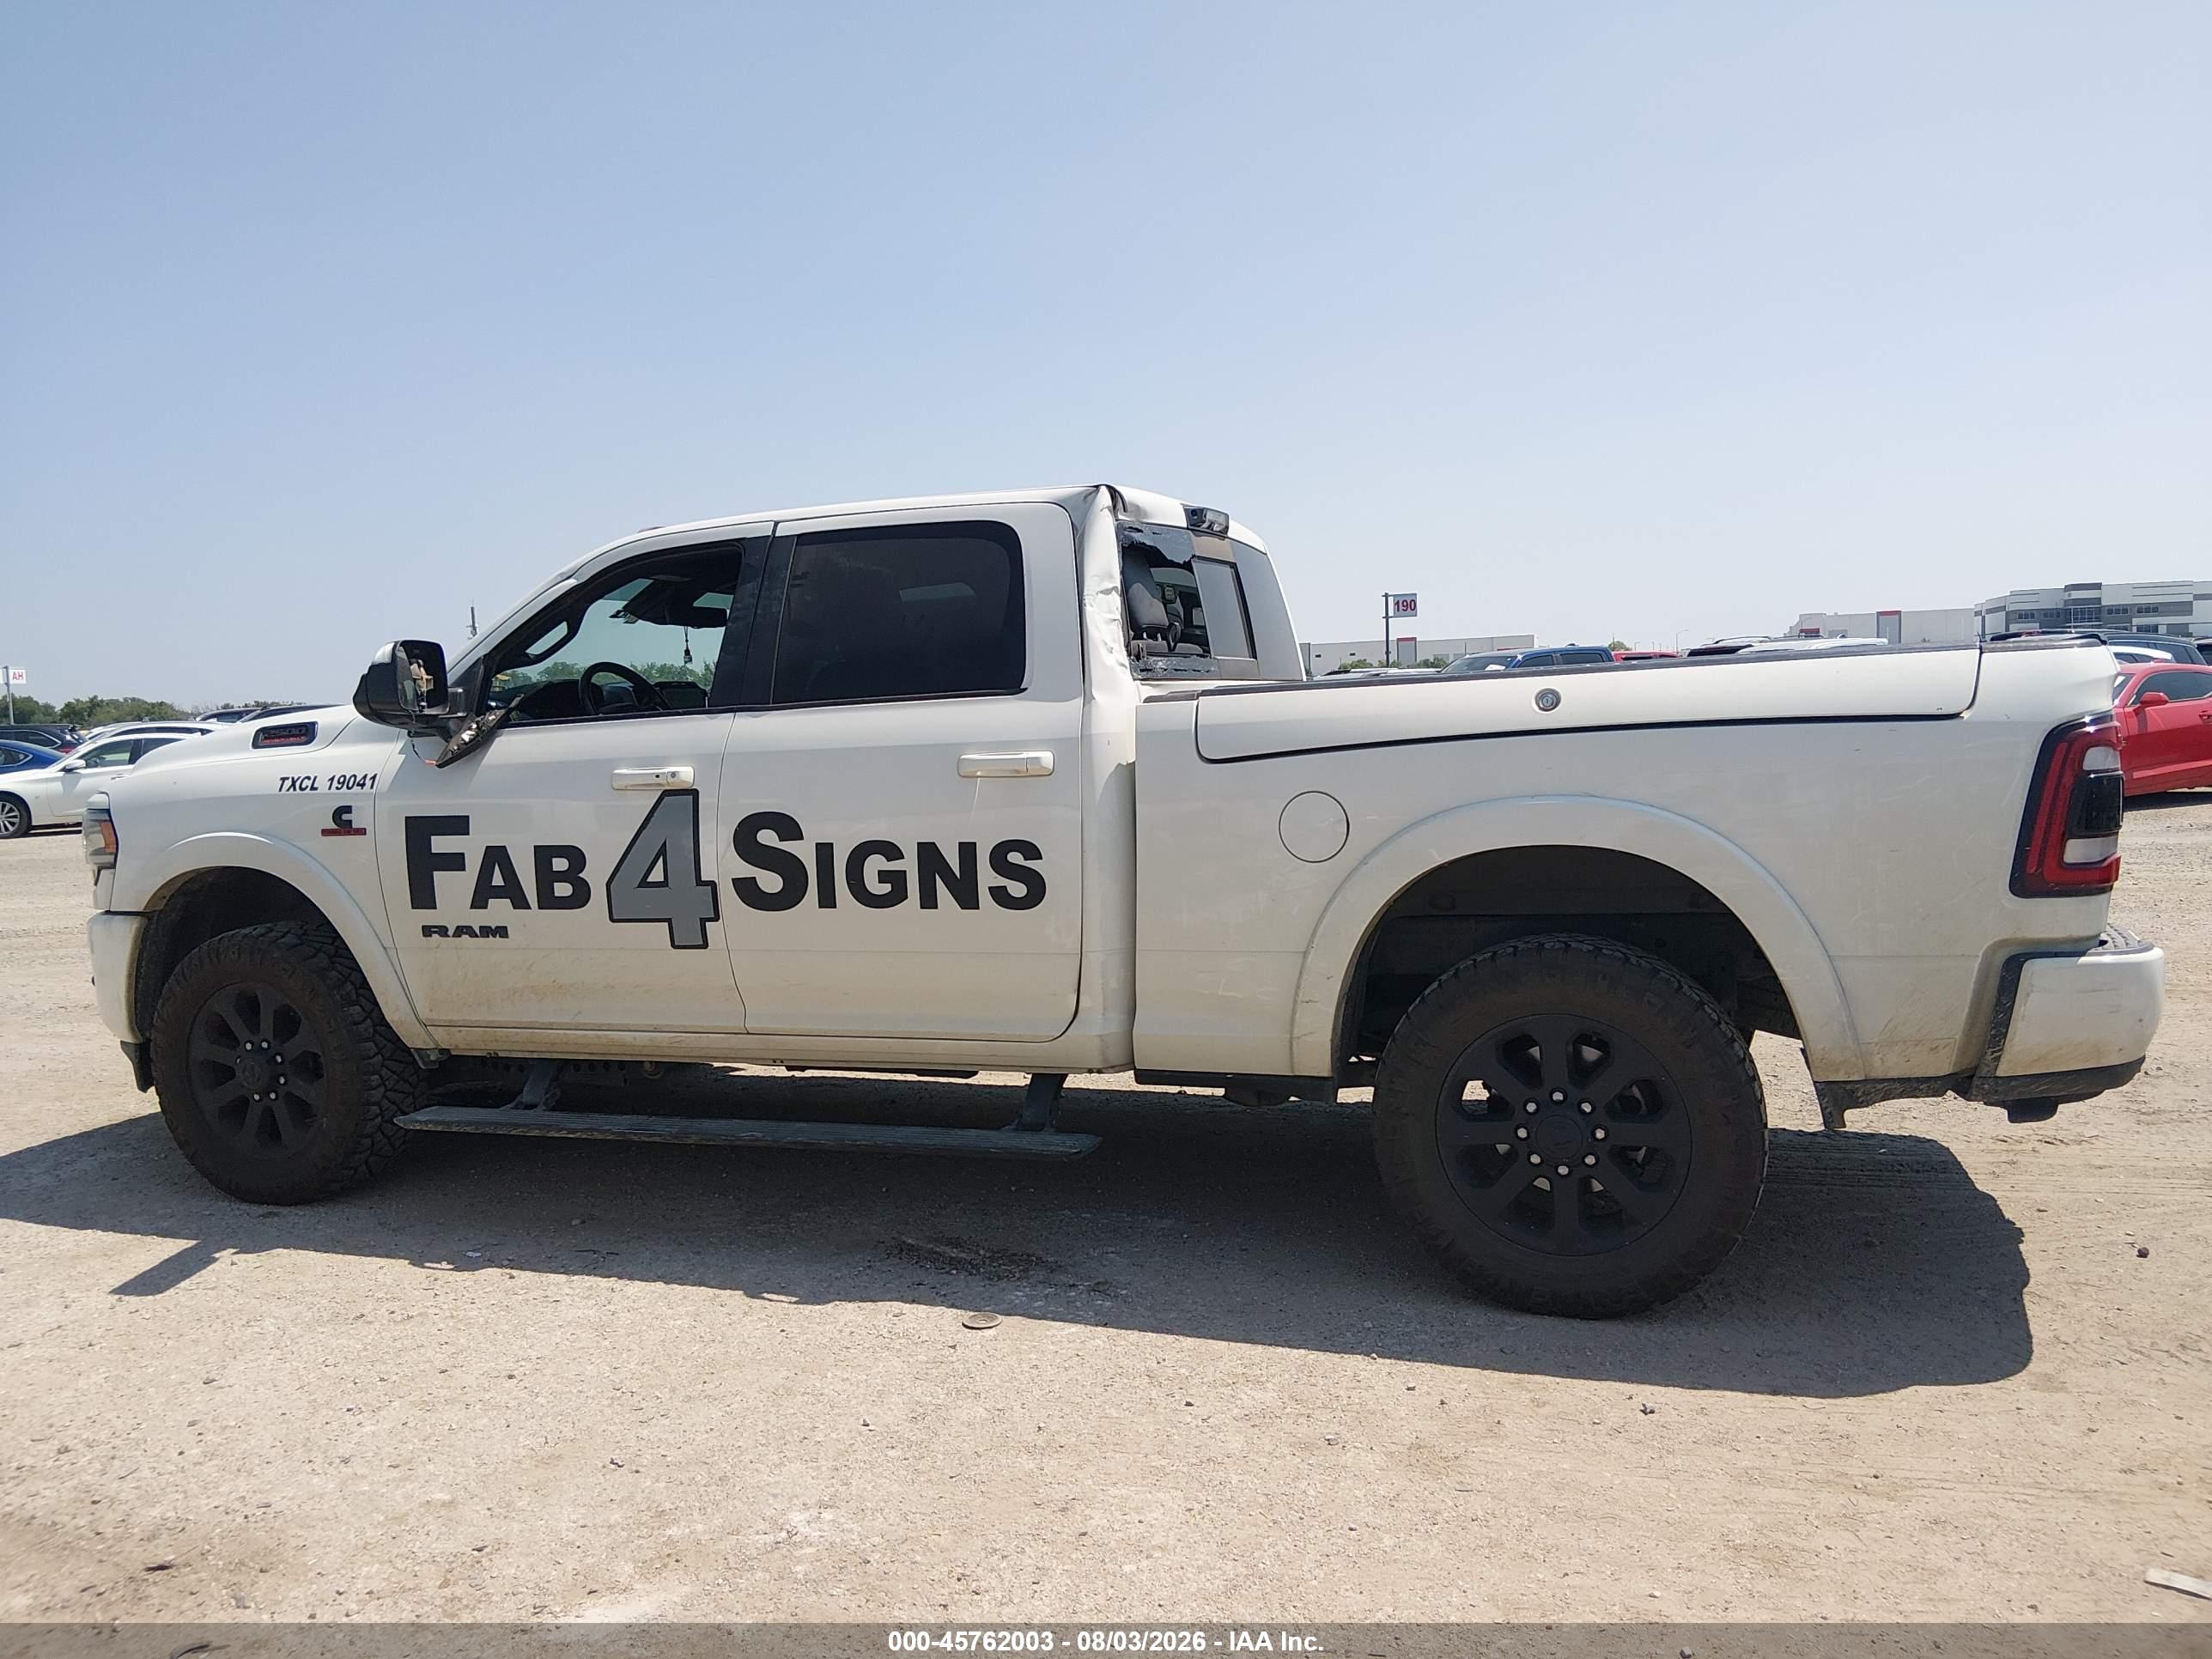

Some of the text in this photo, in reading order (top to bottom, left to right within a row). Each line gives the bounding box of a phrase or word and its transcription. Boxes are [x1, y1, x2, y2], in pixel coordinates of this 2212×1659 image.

[1394, 599, 1417, 612] 190
[12, 671, 24, 681] AH
[278, 773, 378, 793] TXCL 19041
[421, 924, 509, 939] RAM
